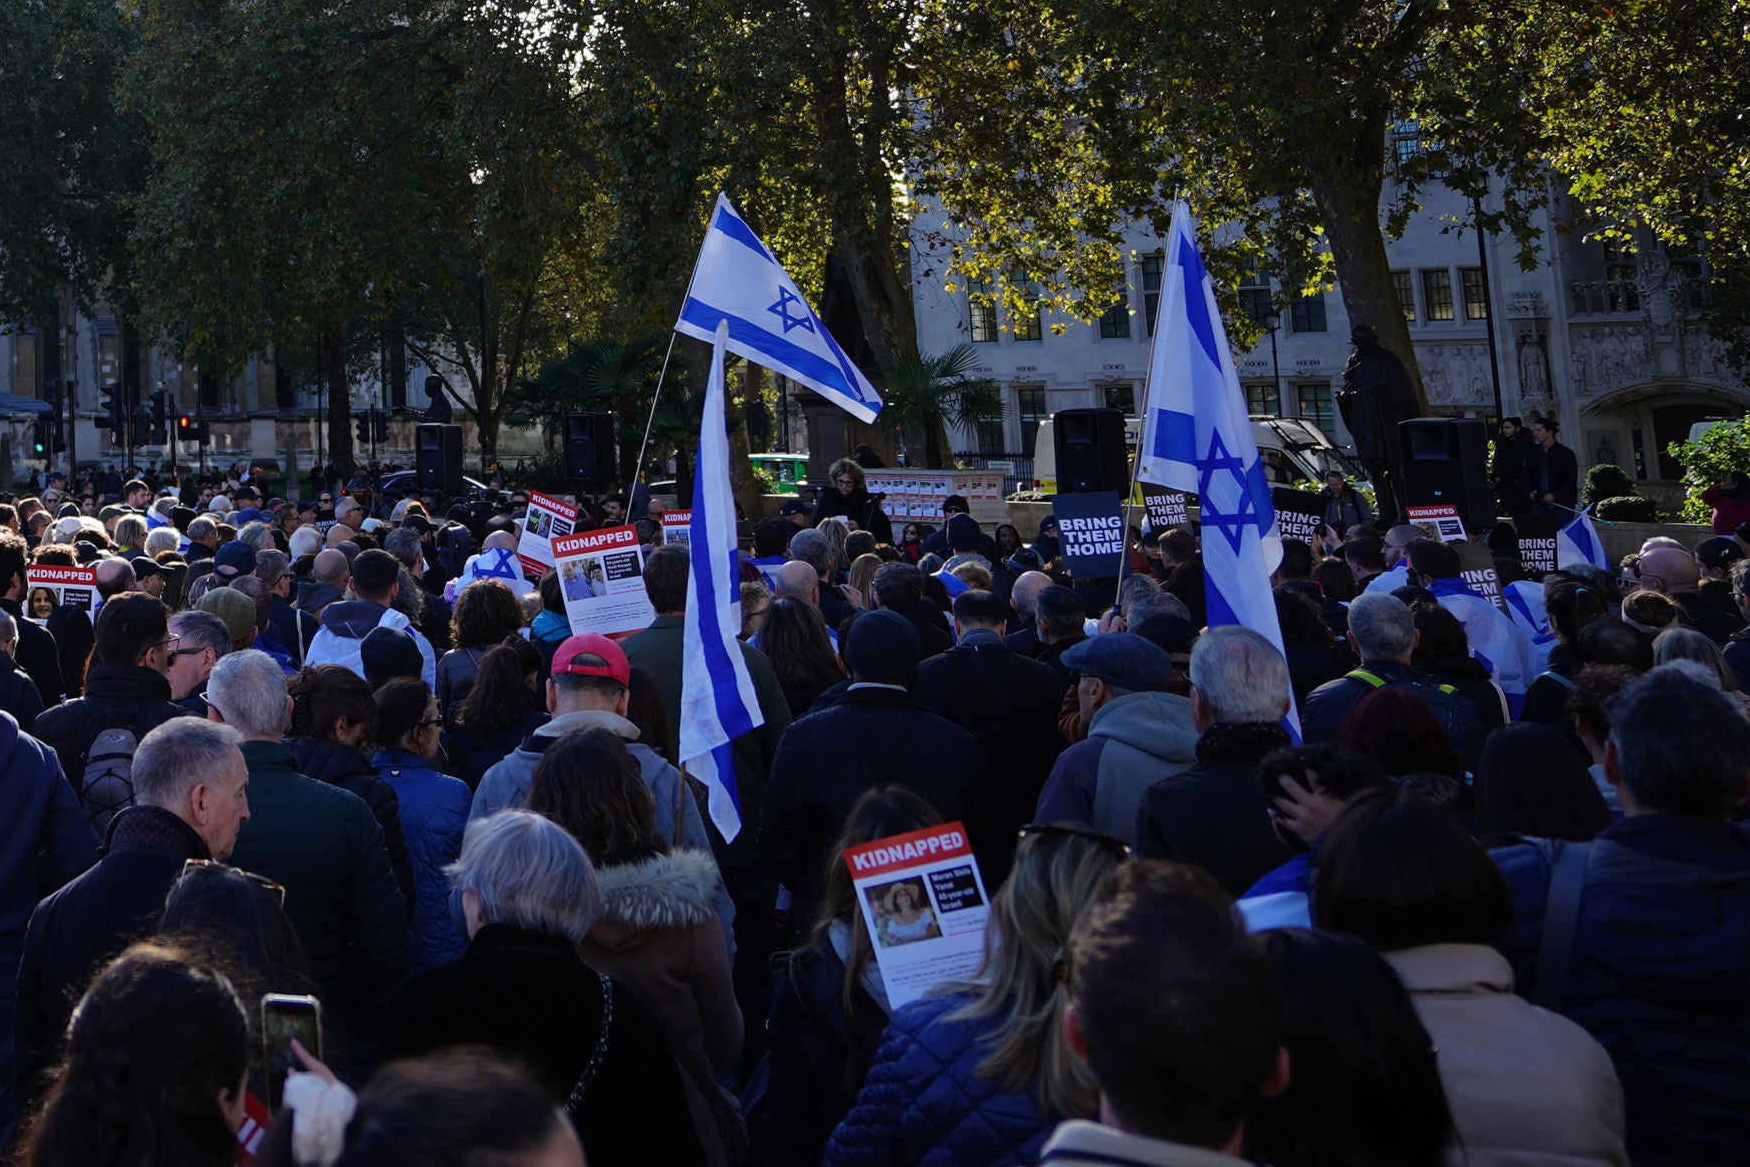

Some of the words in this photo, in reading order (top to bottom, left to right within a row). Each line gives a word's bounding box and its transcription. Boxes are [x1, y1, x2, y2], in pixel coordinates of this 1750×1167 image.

[533, 494, 575, 517] KIDNAPPED
[1145, 494, 1185, 506] BRING
[1149, 504, 1185, 516] THEM
[1409, 508, 1454, 516] KIDNAPPED
[665, 514, 691, 522] KIDNAP
[1058, 516, 1122, 531] BRING
[1150, 514, 1187, 526] HOME
[1278, 522, 1315, 535] HEM
[556, 530, 634, 553] KIDNAPPED
[1064, 528, 1121, 543] THEM
[1065, 541, 1123, 556] HOME
[1518, 538, 1556, 549] BRING
[1520, 550, 1554, 560] THEM
[28, 569, 93, 581] KIDNAPPED
[1460, 568, 1496, 583] ING
[852, 831, 964, 871] KIDNAPPED
